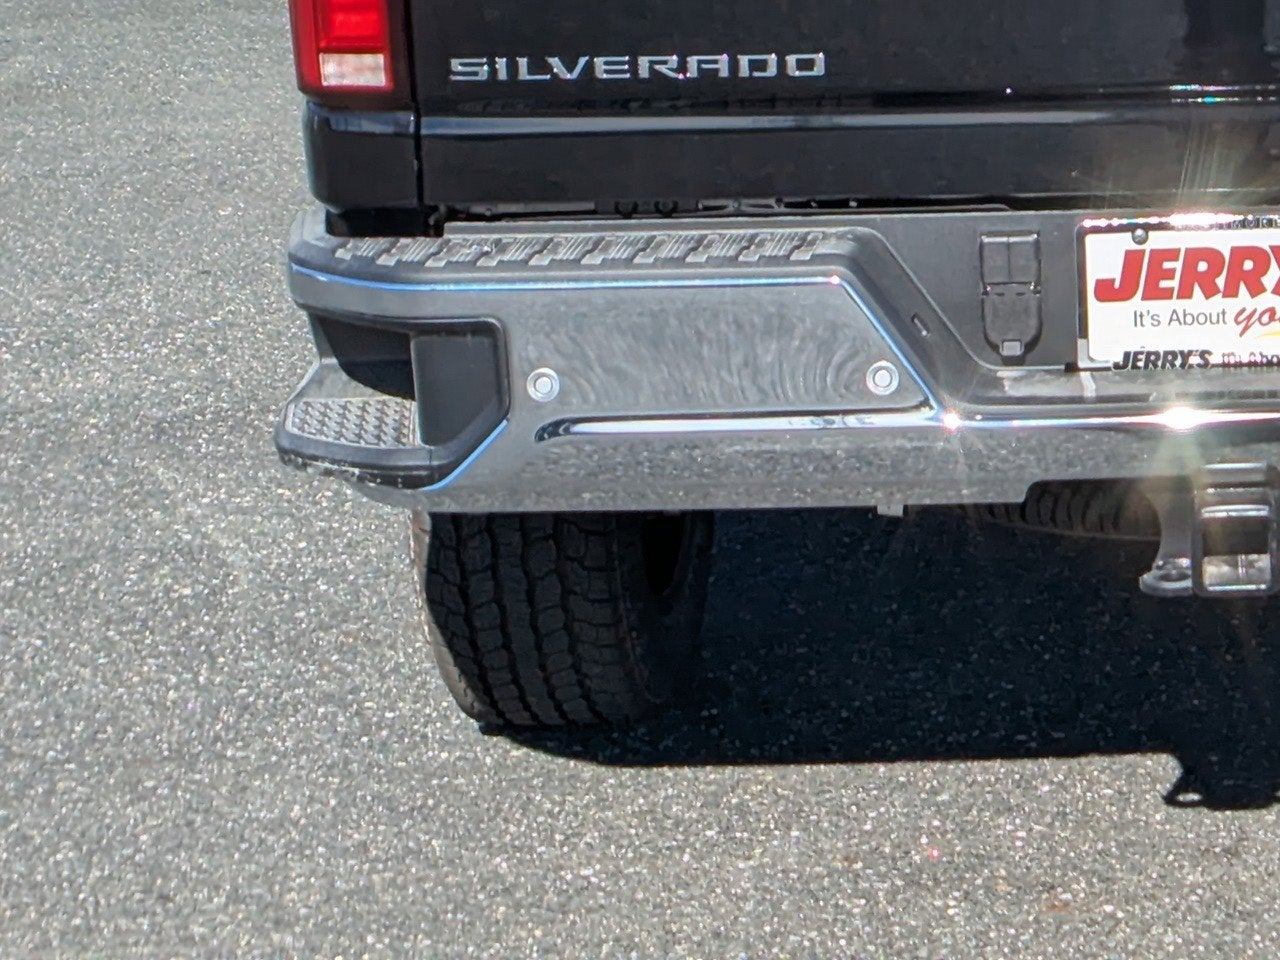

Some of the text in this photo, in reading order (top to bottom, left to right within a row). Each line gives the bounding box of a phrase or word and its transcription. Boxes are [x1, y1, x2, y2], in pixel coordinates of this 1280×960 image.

[449, 52, 827, 81] SILVERADO
[1133, 310, 1161, 328] It's
[1168, 309, 1227, 327] About
[1111, 348, 1214, 371] JERRY'S
